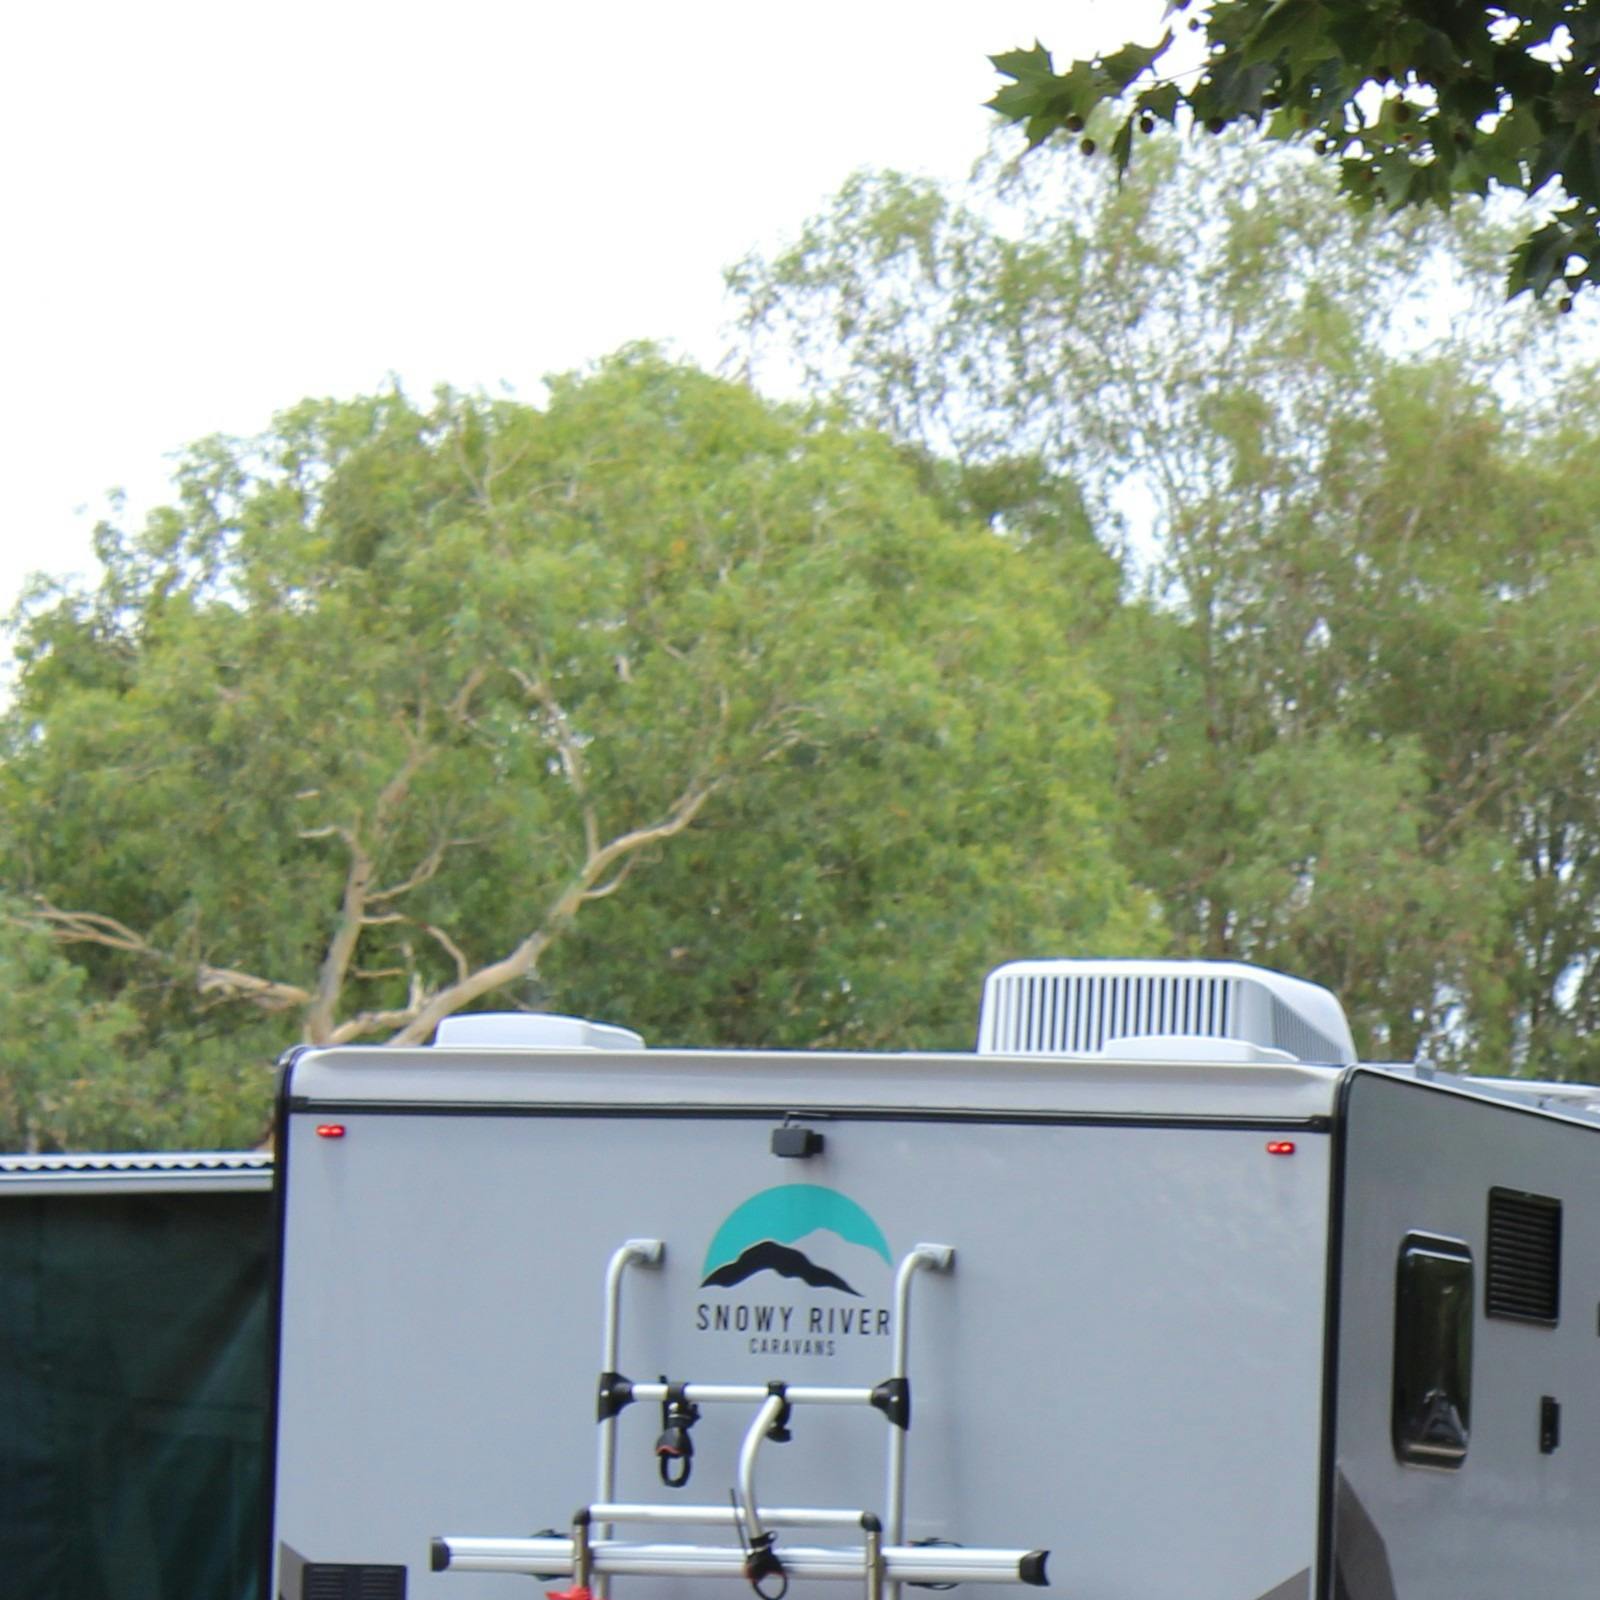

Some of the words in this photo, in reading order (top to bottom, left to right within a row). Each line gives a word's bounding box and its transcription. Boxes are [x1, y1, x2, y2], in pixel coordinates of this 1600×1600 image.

[696, 1304, 794, 1334] SNOWY
[809, 1307, 891, 1336] RIVER
[749, 1338, 836, 1357] CARAVANS
